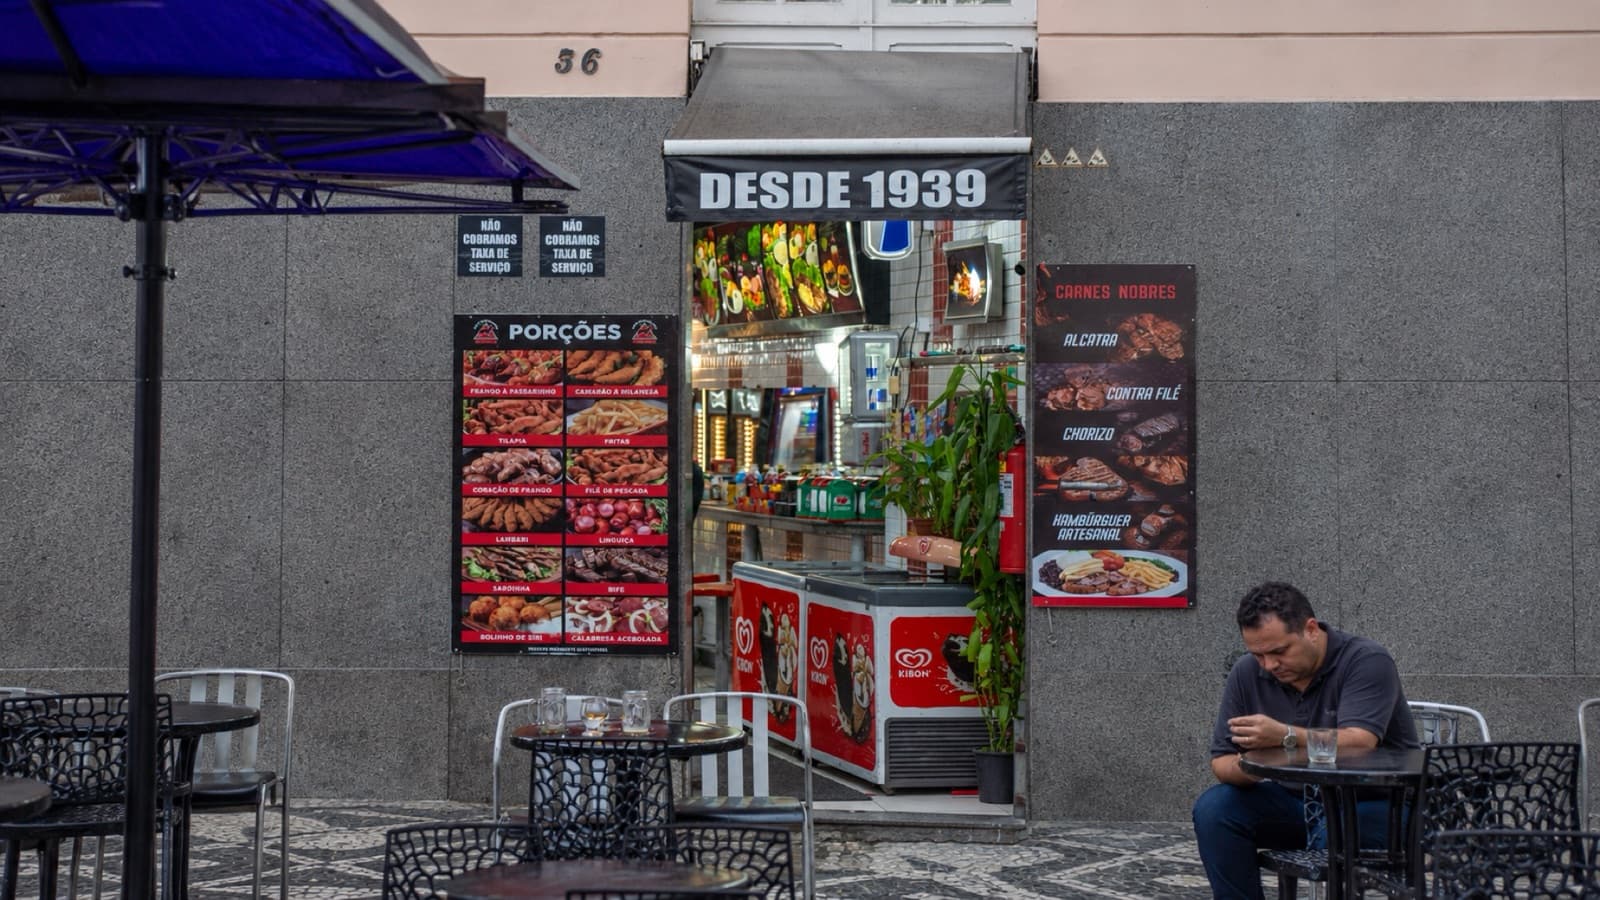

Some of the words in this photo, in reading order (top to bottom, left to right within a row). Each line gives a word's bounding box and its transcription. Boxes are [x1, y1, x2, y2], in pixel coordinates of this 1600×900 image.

[699, 171, 850, 209] DESDE
[862, 168, 988, 208] 1939
[481, 218, 501, 231] NÃO
[563, 219, 583, 232] NÃO
[462, 234, 518, 246] COBRAMOS
[544, 235, 600, 246] COBRAMOS
[470, 248, 495, 259] TAXA
[496, 248, 510, 260] DE
[552, 248, 577, 260] TAXA
[578, 249, 592, 260] DE
[468, 262, 512, 274] SERVIÇO
[550, 263, 594, 275] SERVIÇO
[1055, 284, 1111, 299] CARNES
[1118, 284, 1177, 299] NOBRES
[508, 320, 622, 345] PORÇÕES
[1063, 333, 1119, 347] ALCATRA
[509, 388, 556, 396] PASSARINHO
[1106, 387, 1152, 400] CONTRA
[1155, 384, 1182, 400] FILÉ
[1063, 427, 1115, 441] CHORIZO
[472, 486, 508, 494] CORAÇÃO
[614, 488, 648, 496] PESCADA
[1052, 512, 1132, 527] HAMBÚRGUER
[496, 536, 528, 544] LAMBARI
[1057, 528, 1121, 541] ARTESANAL
[608, 586, 624, 594] BIFE
[480, 634, 514, 642] BOLINHO
[515, 634, 526, 642] DE
[528, 634, 542, 642] SIRI
[572, 634, 614, 642] CALABRESA
[898, 669, 930, 678] KIBON
